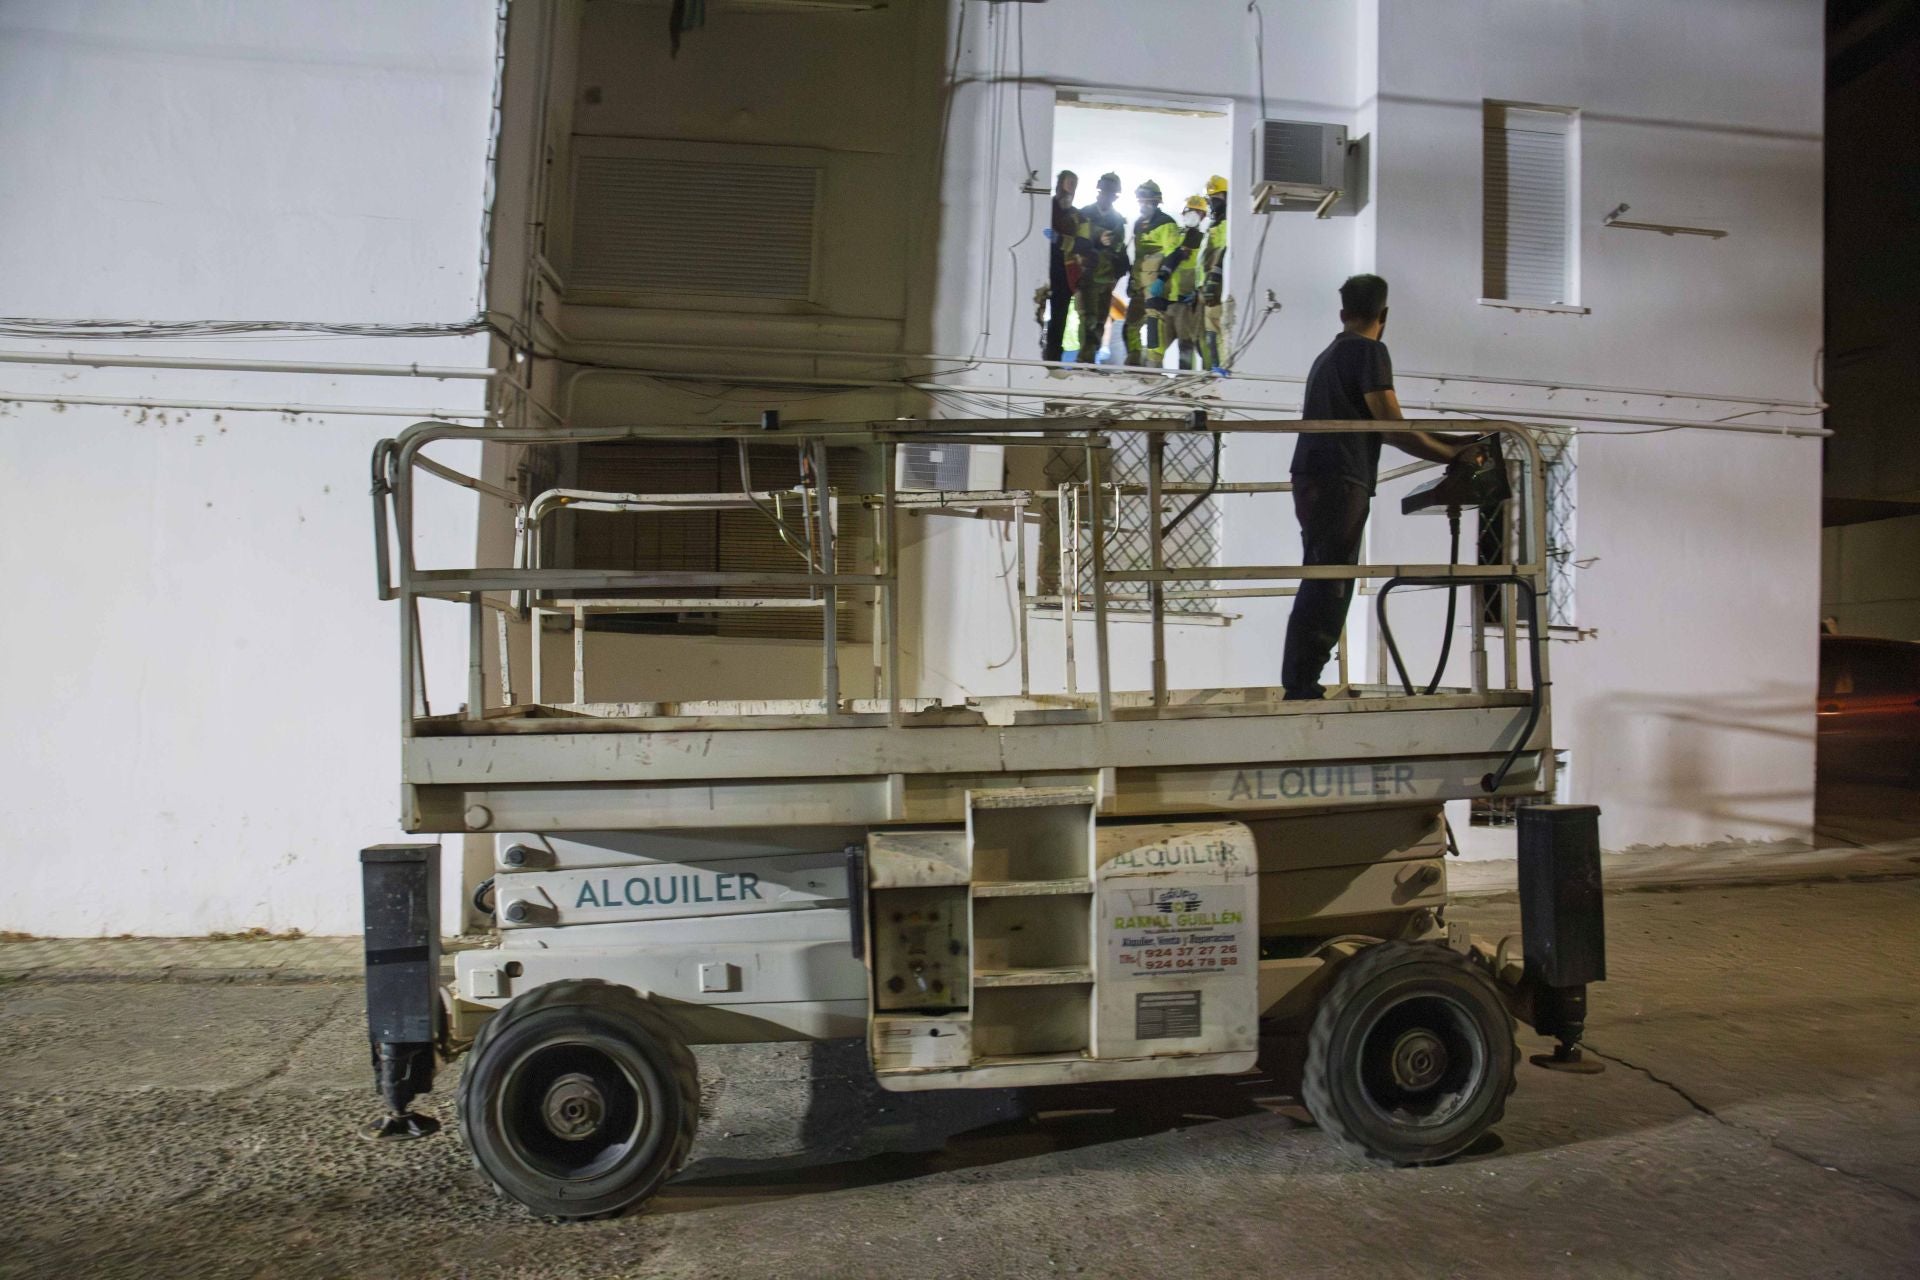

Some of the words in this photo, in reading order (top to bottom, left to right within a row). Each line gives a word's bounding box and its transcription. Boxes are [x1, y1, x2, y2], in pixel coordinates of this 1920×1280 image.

[1229, 765, 1417, 801] ALQUILER
[1113, 841, 1239, 868] ALQUILER
[575, 872, 763, 908] ALQUILER
[1145, 948, 1172, 958] 924
[1176, 947, 1194, 956] 37
[1199, 946, 1217, 955] 27
[1145, 960, 1172, 970] 924
